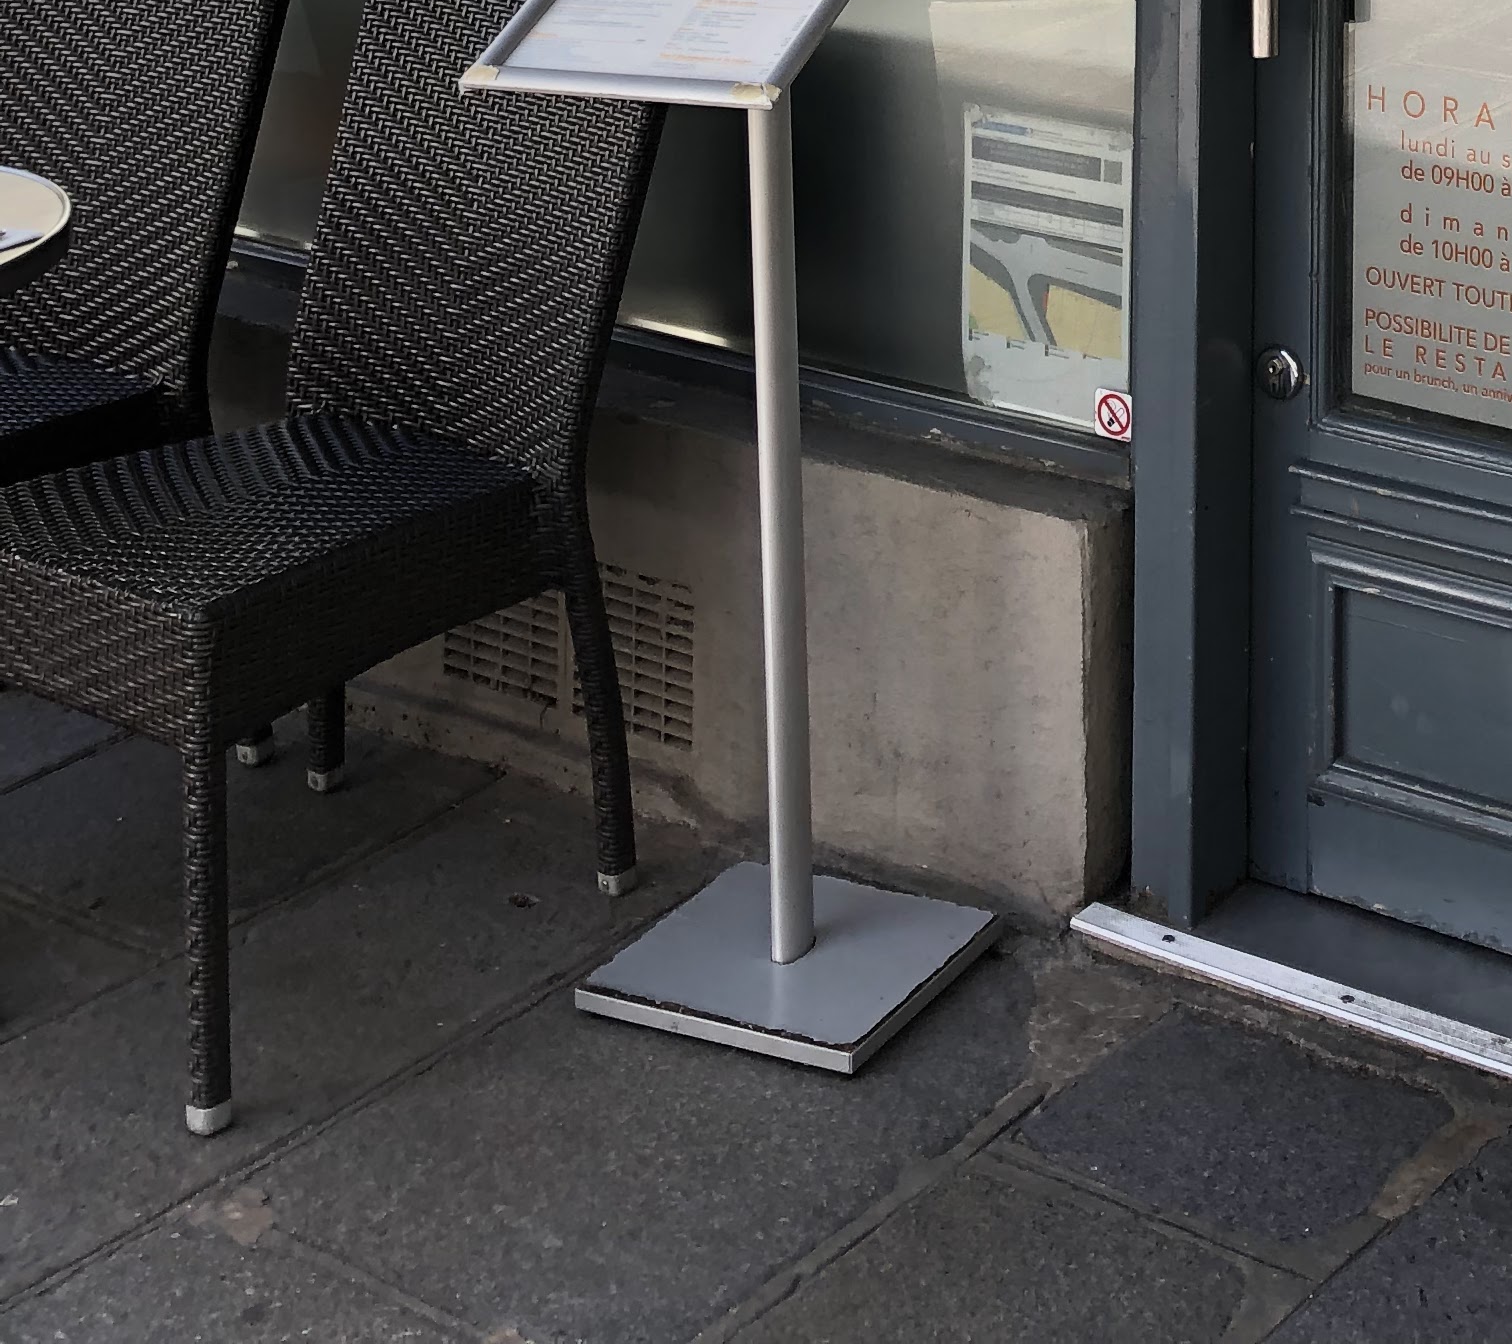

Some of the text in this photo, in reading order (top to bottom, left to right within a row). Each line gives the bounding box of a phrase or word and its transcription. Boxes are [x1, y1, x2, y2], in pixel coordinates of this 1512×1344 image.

[1400, 130, 1456, 160] lundi
[1466, 148, 1491, 166] au
[1401, 160, 1426, 183] de
[1431, 165, 1495, 195] 09H00
[1501, 176, 1512, 198] à
[1400, 232, 1425, 256] de
[1431, 239, 1494, 269] 10H00
[1500, 251, 1511, 273] à
[1365, 266, 1446, 299] OUVERT
[1365, 308, 1478, 349] POSSIBILITE
[1484, 333, 1511, 356] DE
[1365, 335, 1394, 359] LE
[1395, 367, 1411, 381] un
[1462, 380, 1479, 396] un
